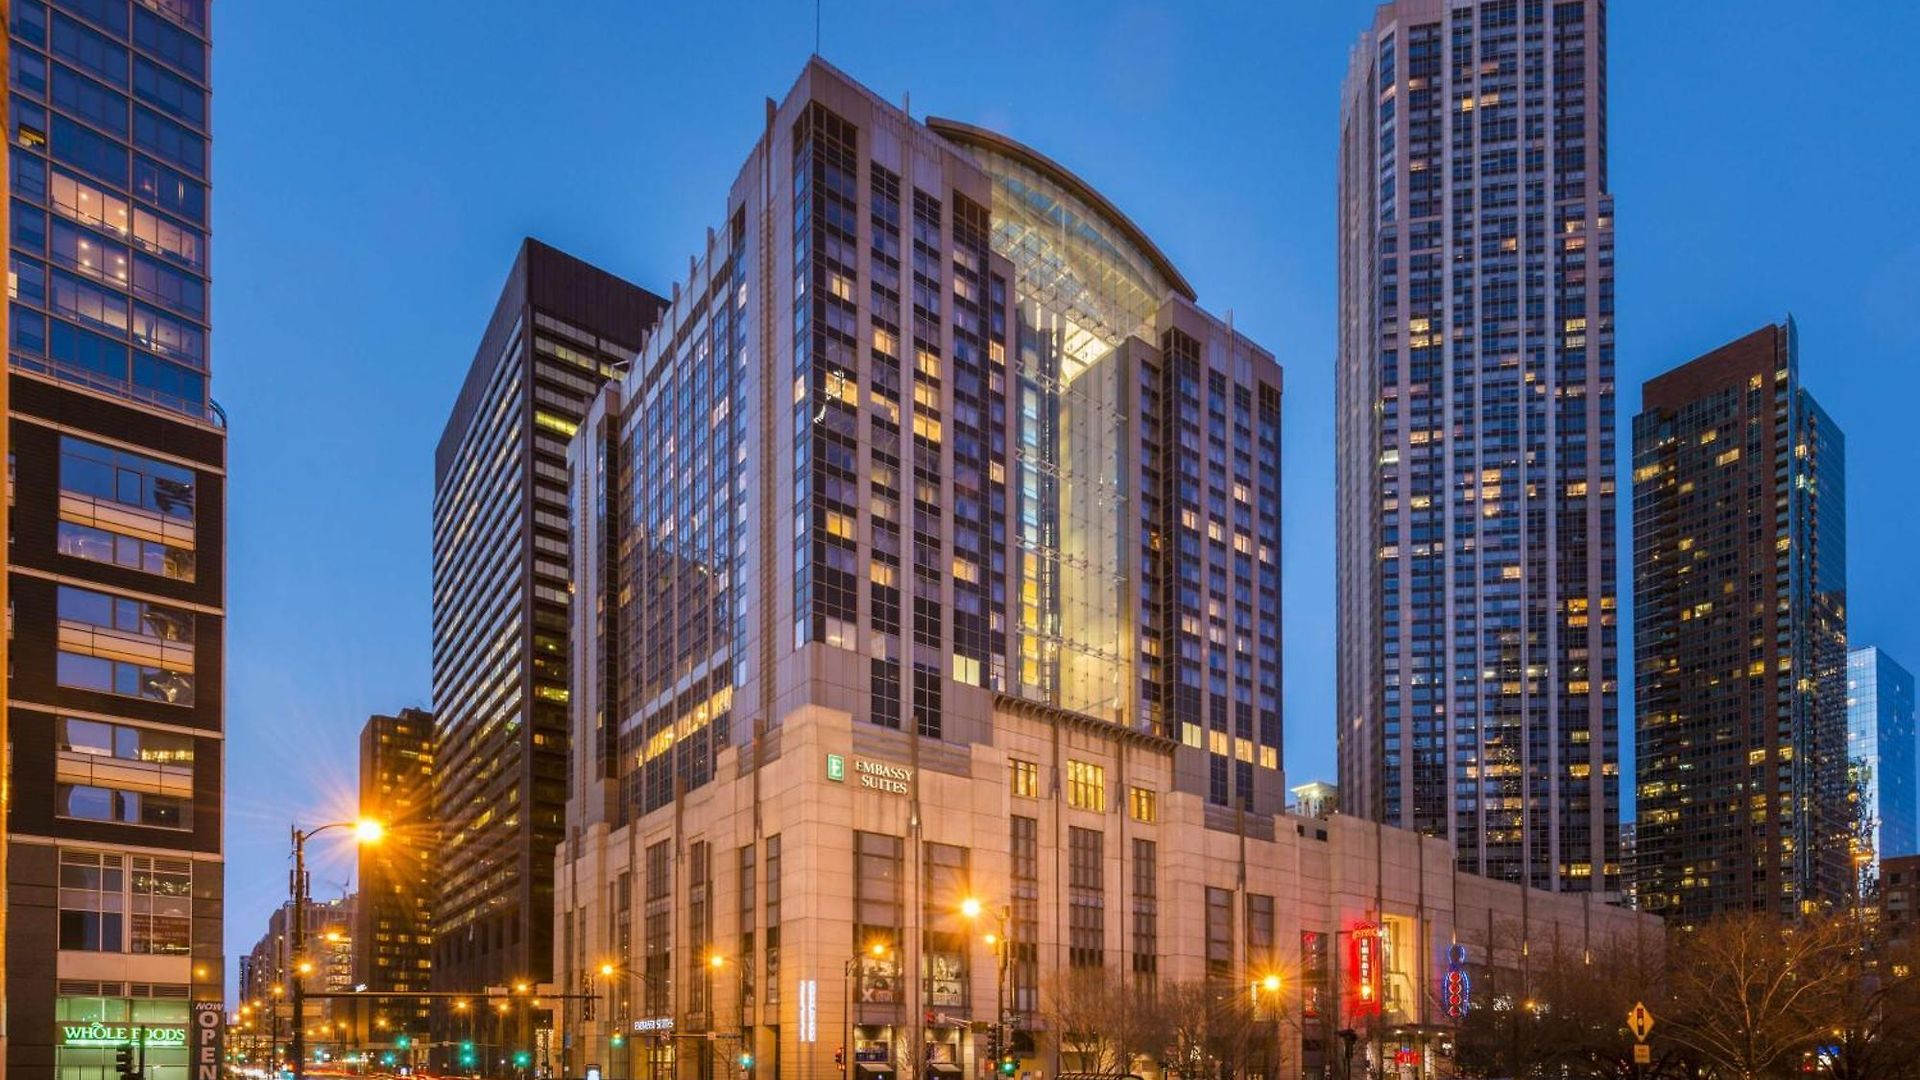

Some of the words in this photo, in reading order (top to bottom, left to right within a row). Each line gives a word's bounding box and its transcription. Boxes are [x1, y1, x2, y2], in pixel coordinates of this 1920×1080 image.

[856, 760, 914, 781] EMBASSY
[861, 775, 908, 794] SUITES
[195, 1002, 224, 1010] NOW
[63, 1025, 128, 1040] WHOLE
[130, 1027, 186, 1041] FOODS
[199, 1011, 219, 1080] OPEN
